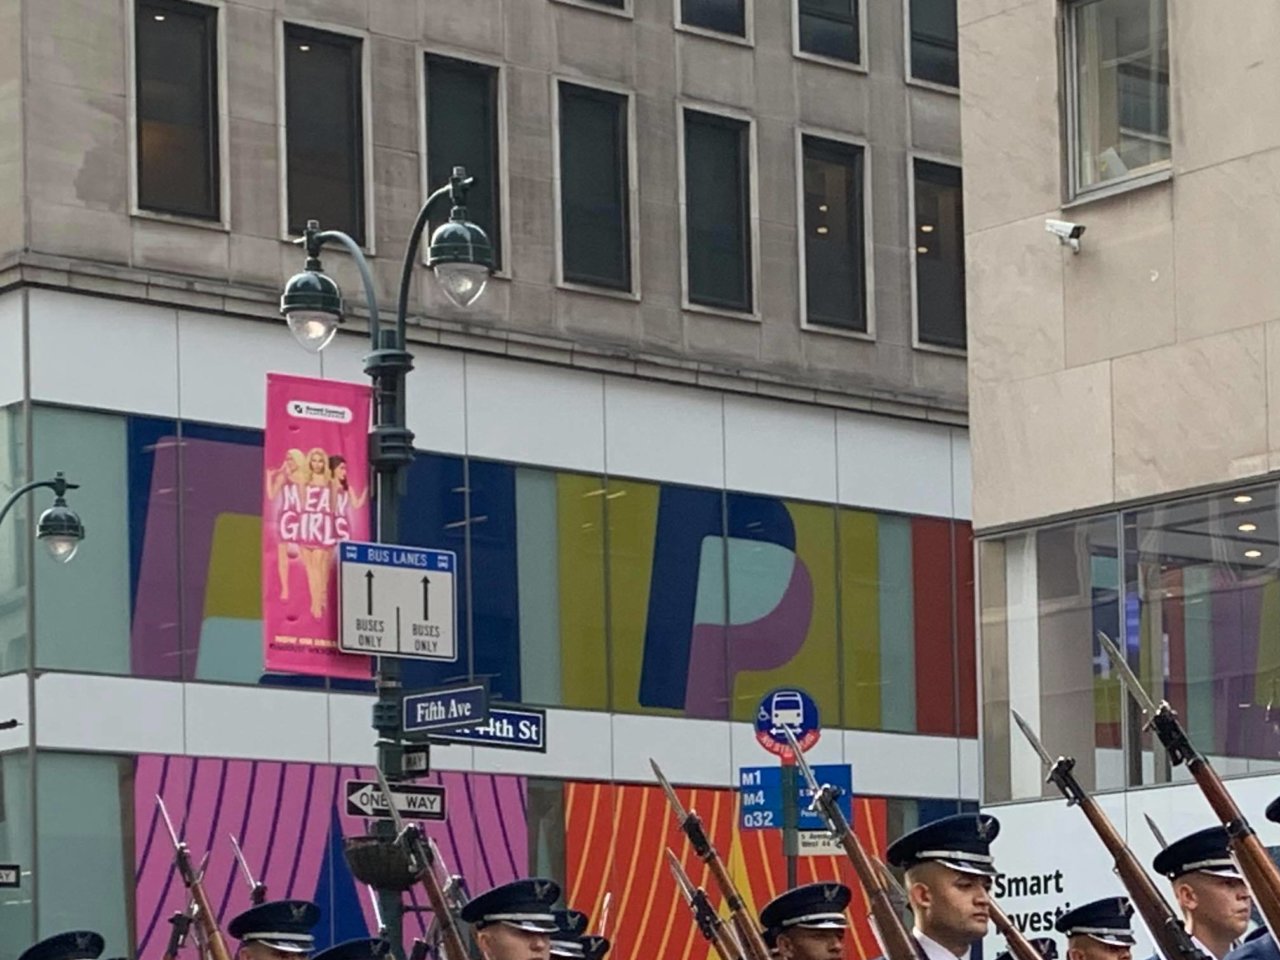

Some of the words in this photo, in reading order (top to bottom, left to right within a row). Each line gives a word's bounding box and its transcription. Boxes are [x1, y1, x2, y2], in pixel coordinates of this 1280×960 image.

[283, 484, 348, 517] MEAN
[280, 511, 350, 545] GIRLS
[367, 548, 390, 563] BUS
[393, 551, 428, 567] LANES
[356, 618, 385, 633] BUSES
[412, 623, 440, 638] BUSES
[358, 634, 383, 648] ONLY
[414, 639, 438, 653] ONLY
[416, 701, 446, 723] Fifth
[448, 699, 472, 718] Ave
[474, 717, 514, 738] 4th
[518, 720, 539, 741] St
[741, 769, 762, 786] M1
[359, 791, 389, 807] ONE
[405, 795, 438, 811] WAY
[743, 790, 765, 806] M4
[744, 811, 774, 828] Q32
[994, 869, 1064, 899] Smart
